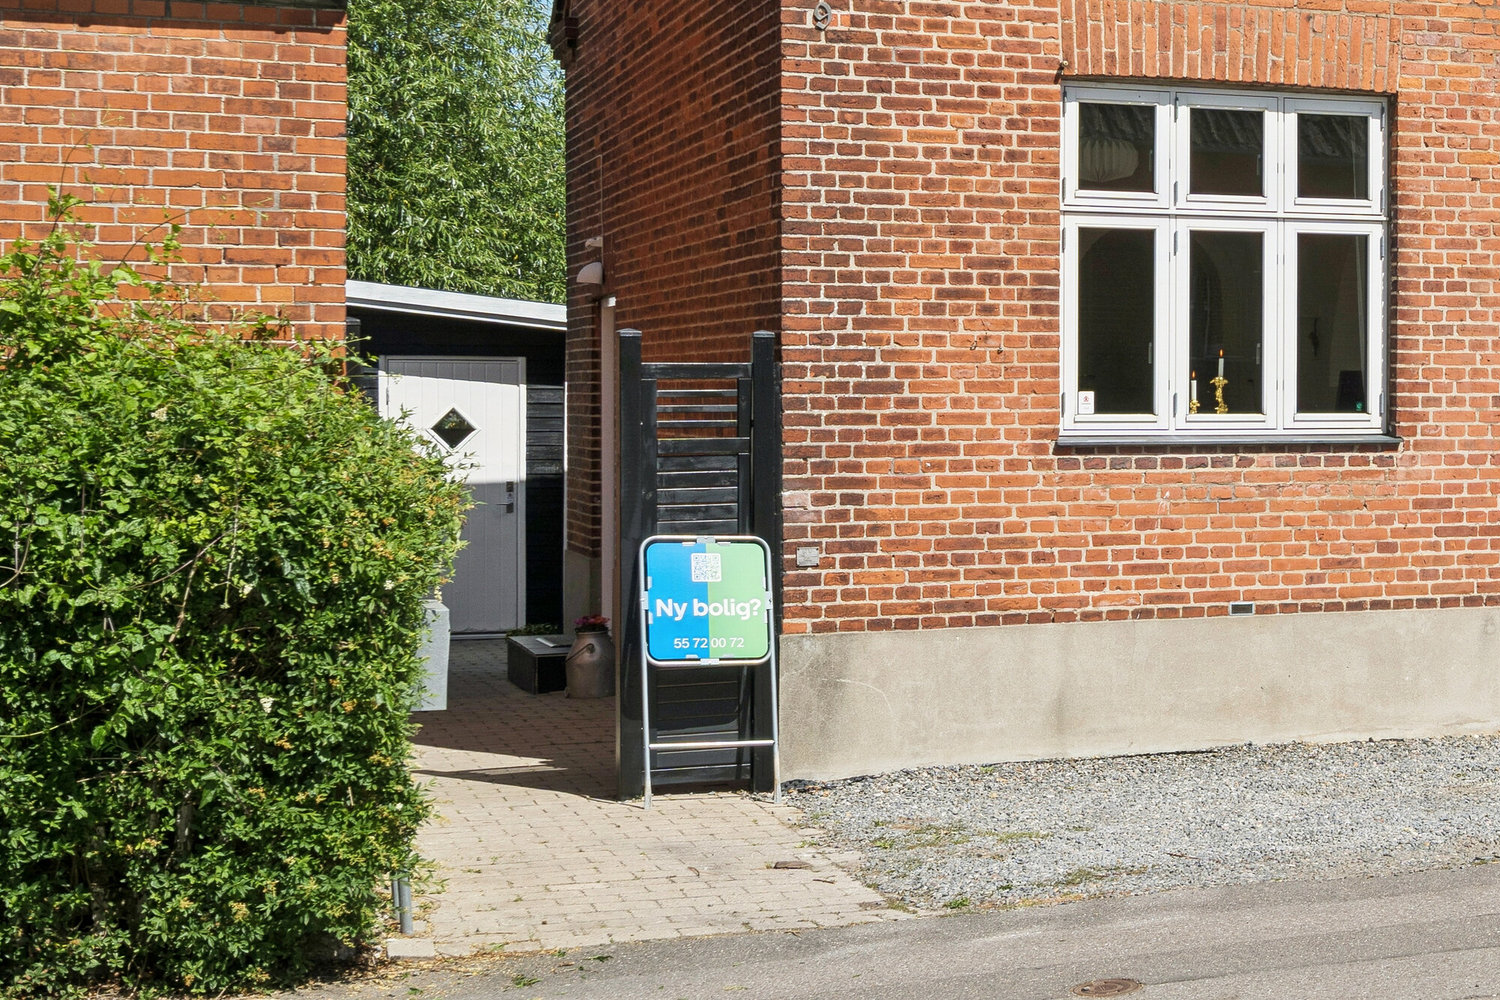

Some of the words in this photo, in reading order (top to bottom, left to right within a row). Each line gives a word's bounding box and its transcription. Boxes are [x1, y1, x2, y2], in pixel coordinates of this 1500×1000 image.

[814, 1, 832, 30] 9
[656, 598, 688, 621] Ny
[693, 598, 762, 621] bolig?
[673, 637, 690, 649] 55
[692, 637, 708, 649] 72
[710, 637, 727, 649] 00
[729, 637, 745, 649] 72
